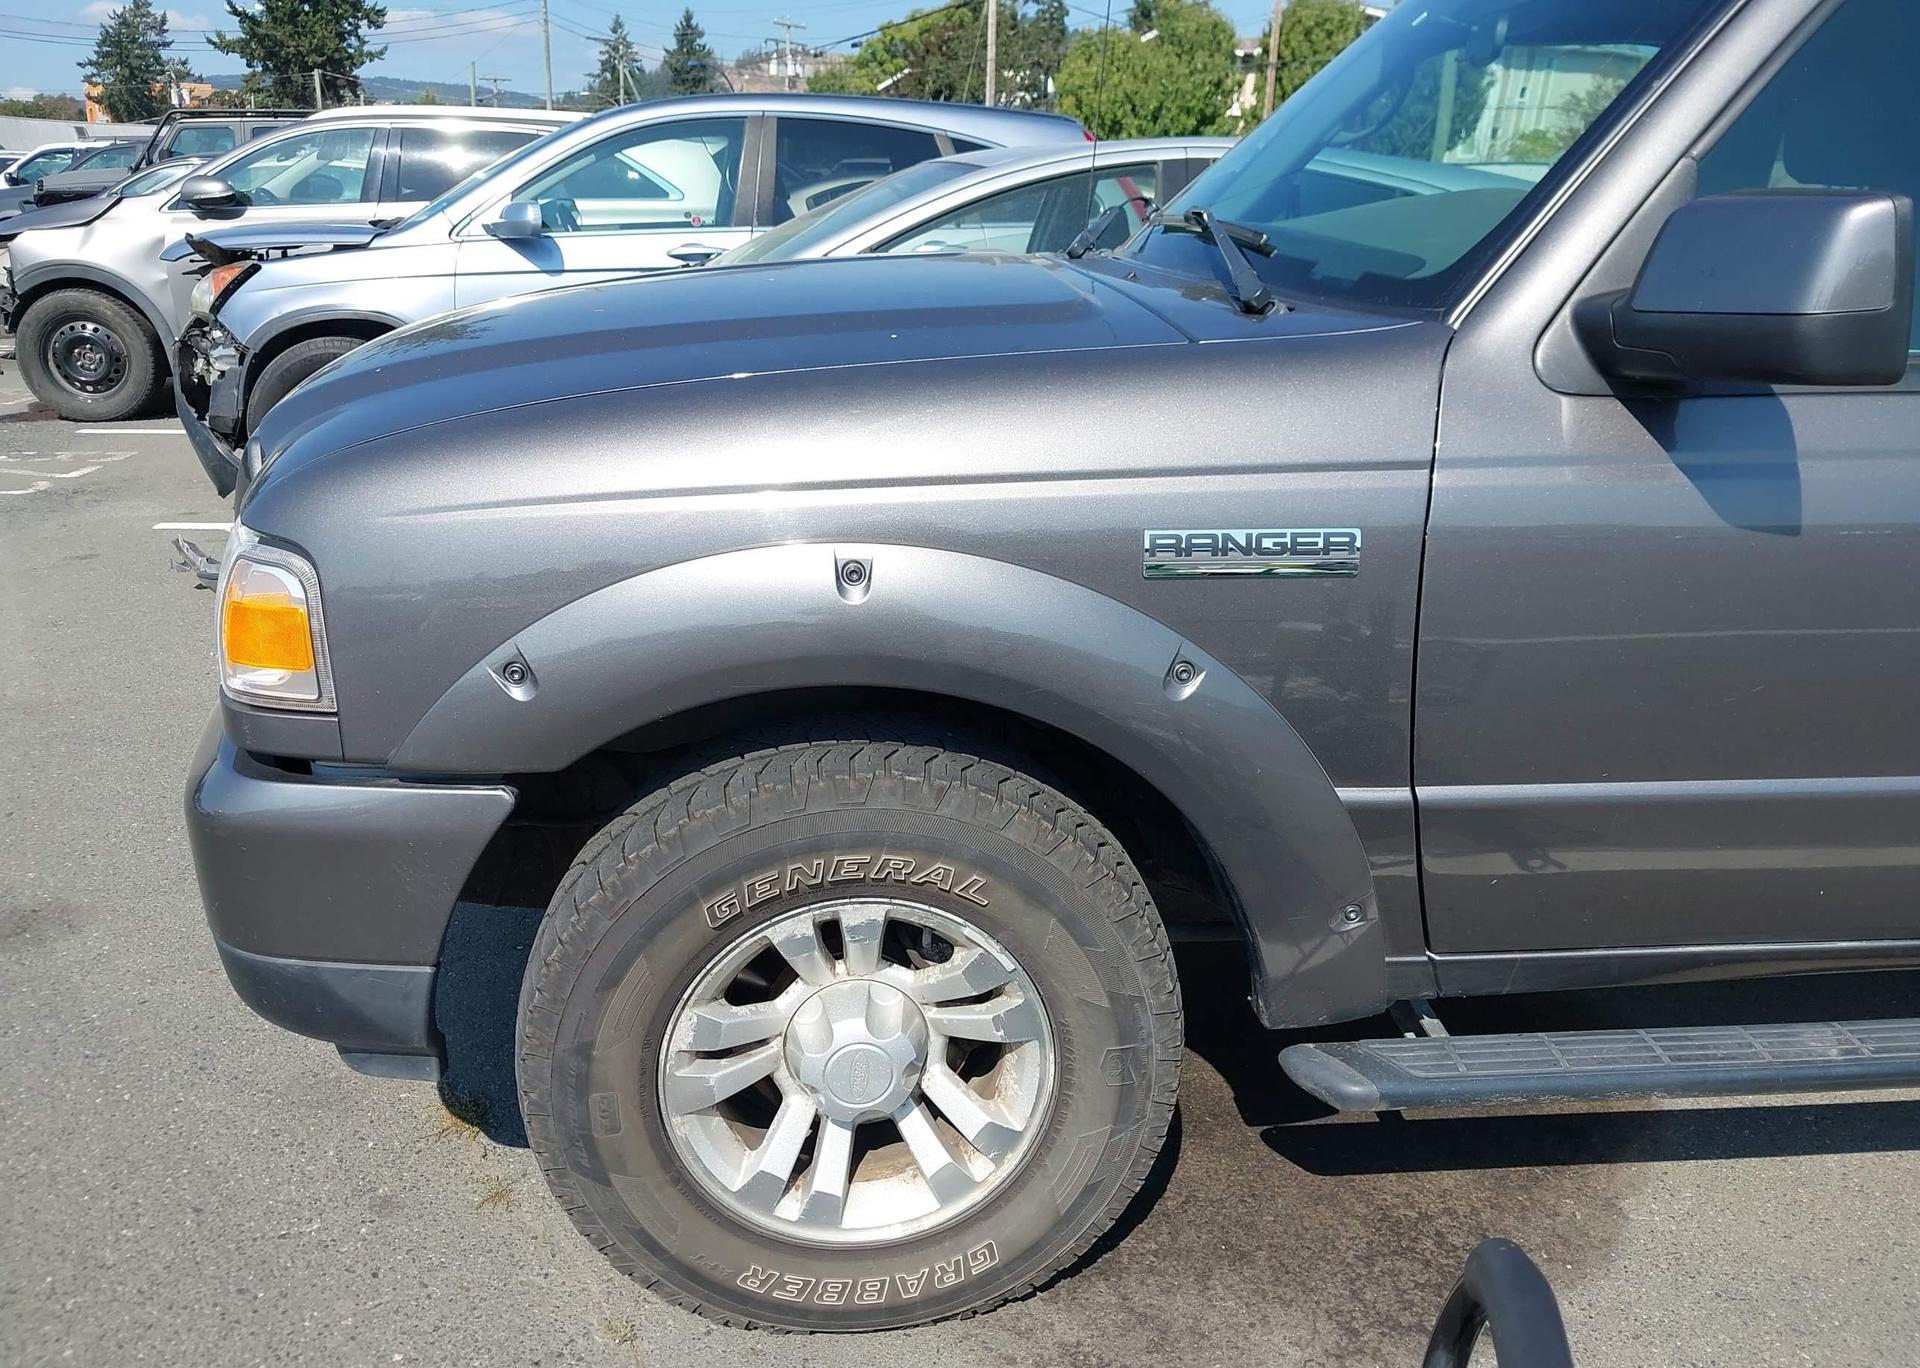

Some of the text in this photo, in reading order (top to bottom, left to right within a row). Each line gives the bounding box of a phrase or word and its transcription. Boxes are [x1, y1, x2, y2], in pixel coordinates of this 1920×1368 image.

[1147, 531, 1359, 558] RANGER
[703, 854, 991, 929] GENERAL
[736, 1239, 1000, 1305] GRABBER
